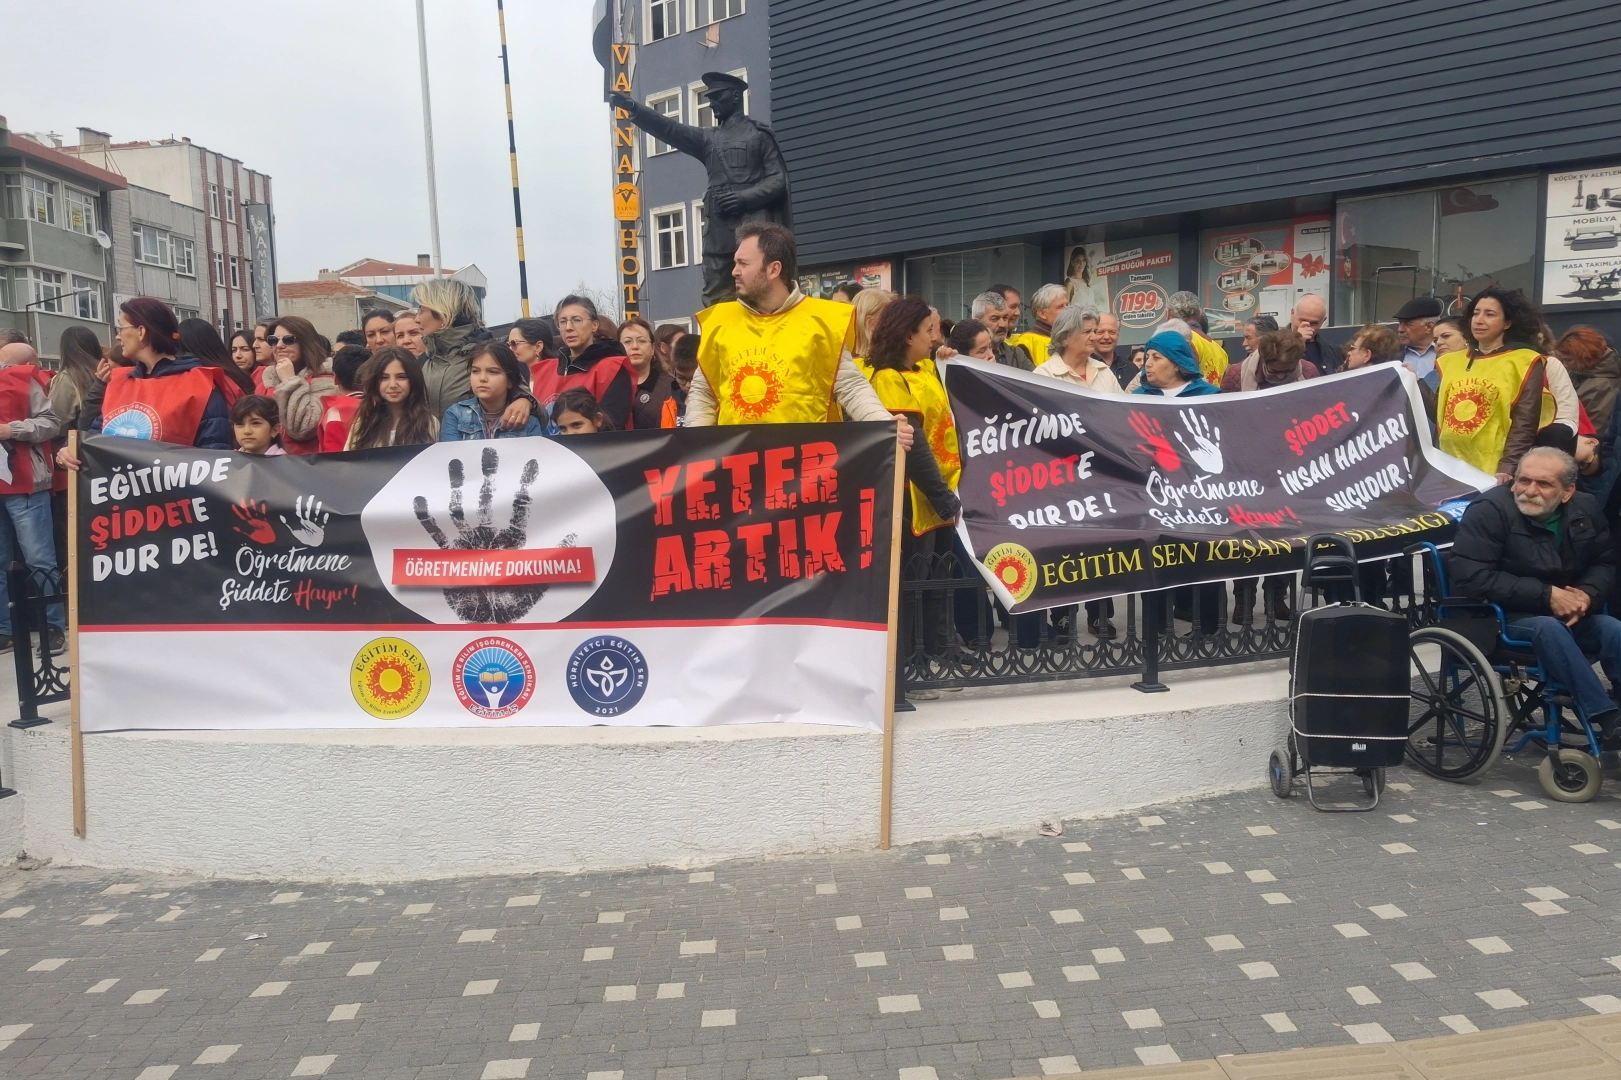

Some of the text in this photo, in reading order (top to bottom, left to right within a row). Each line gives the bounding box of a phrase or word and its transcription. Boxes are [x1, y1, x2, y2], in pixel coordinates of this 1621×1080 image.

[1554, 174, 1578, 182] KÜÇÜK
[1573, 216, 1617, 225] MOBİLYA
[256, 236, 270, 314] AMERİKAN
[1121, 260, 1145, 271] DÜĞÜN
[1146, 253, 1172, 266] PAKETİ
[1562, 262, 1583, 270] MASA
[1445, 377, 1478, 396] İTİM
[966, 408, 1086, 458] EĞİTİMDE
[1277, 413, 1409, 495] İNSAN HAKLARI
[90, 458, 232, 504] EĞİTİMDE
[644, 441, 839, 526] YETER
[990, 451, 1094, 507] ŞİDDETE
[1146, 466, 1264, 507] Öğretmene
[90, 497, 210, 550] ŞİDDETE
[1008, 504, 1066, 529] DUR
[1148, 506, 1229, 529] Şiddete
[92, 531, 218, 581] DUR DE!
[236, 543, 352, 578] Öğretmene
[405, 558, 582, 576] ÖĞRETMENİME DOKUNMA!
[1016, 550, 1032, 566] SEN
[1041, 547, 1144, 587] EĞİTİM
[1152, 542, 1199, 569] SEN
[1206, 537, 1292, 563] KEŞAN
[220, 578, 292, 610] Şiddete
[356, 642, 424, 672] EĞİTİM SEN
[454, 639, 534, 701] EĞİTİM VE BİLİM İŞGÖRENLERİ SENDİKASI
[570, 639, 644, 687] HÜRRİYETÇİ EĞİTİM SEN
[595, 706, 619, 714] 2021
